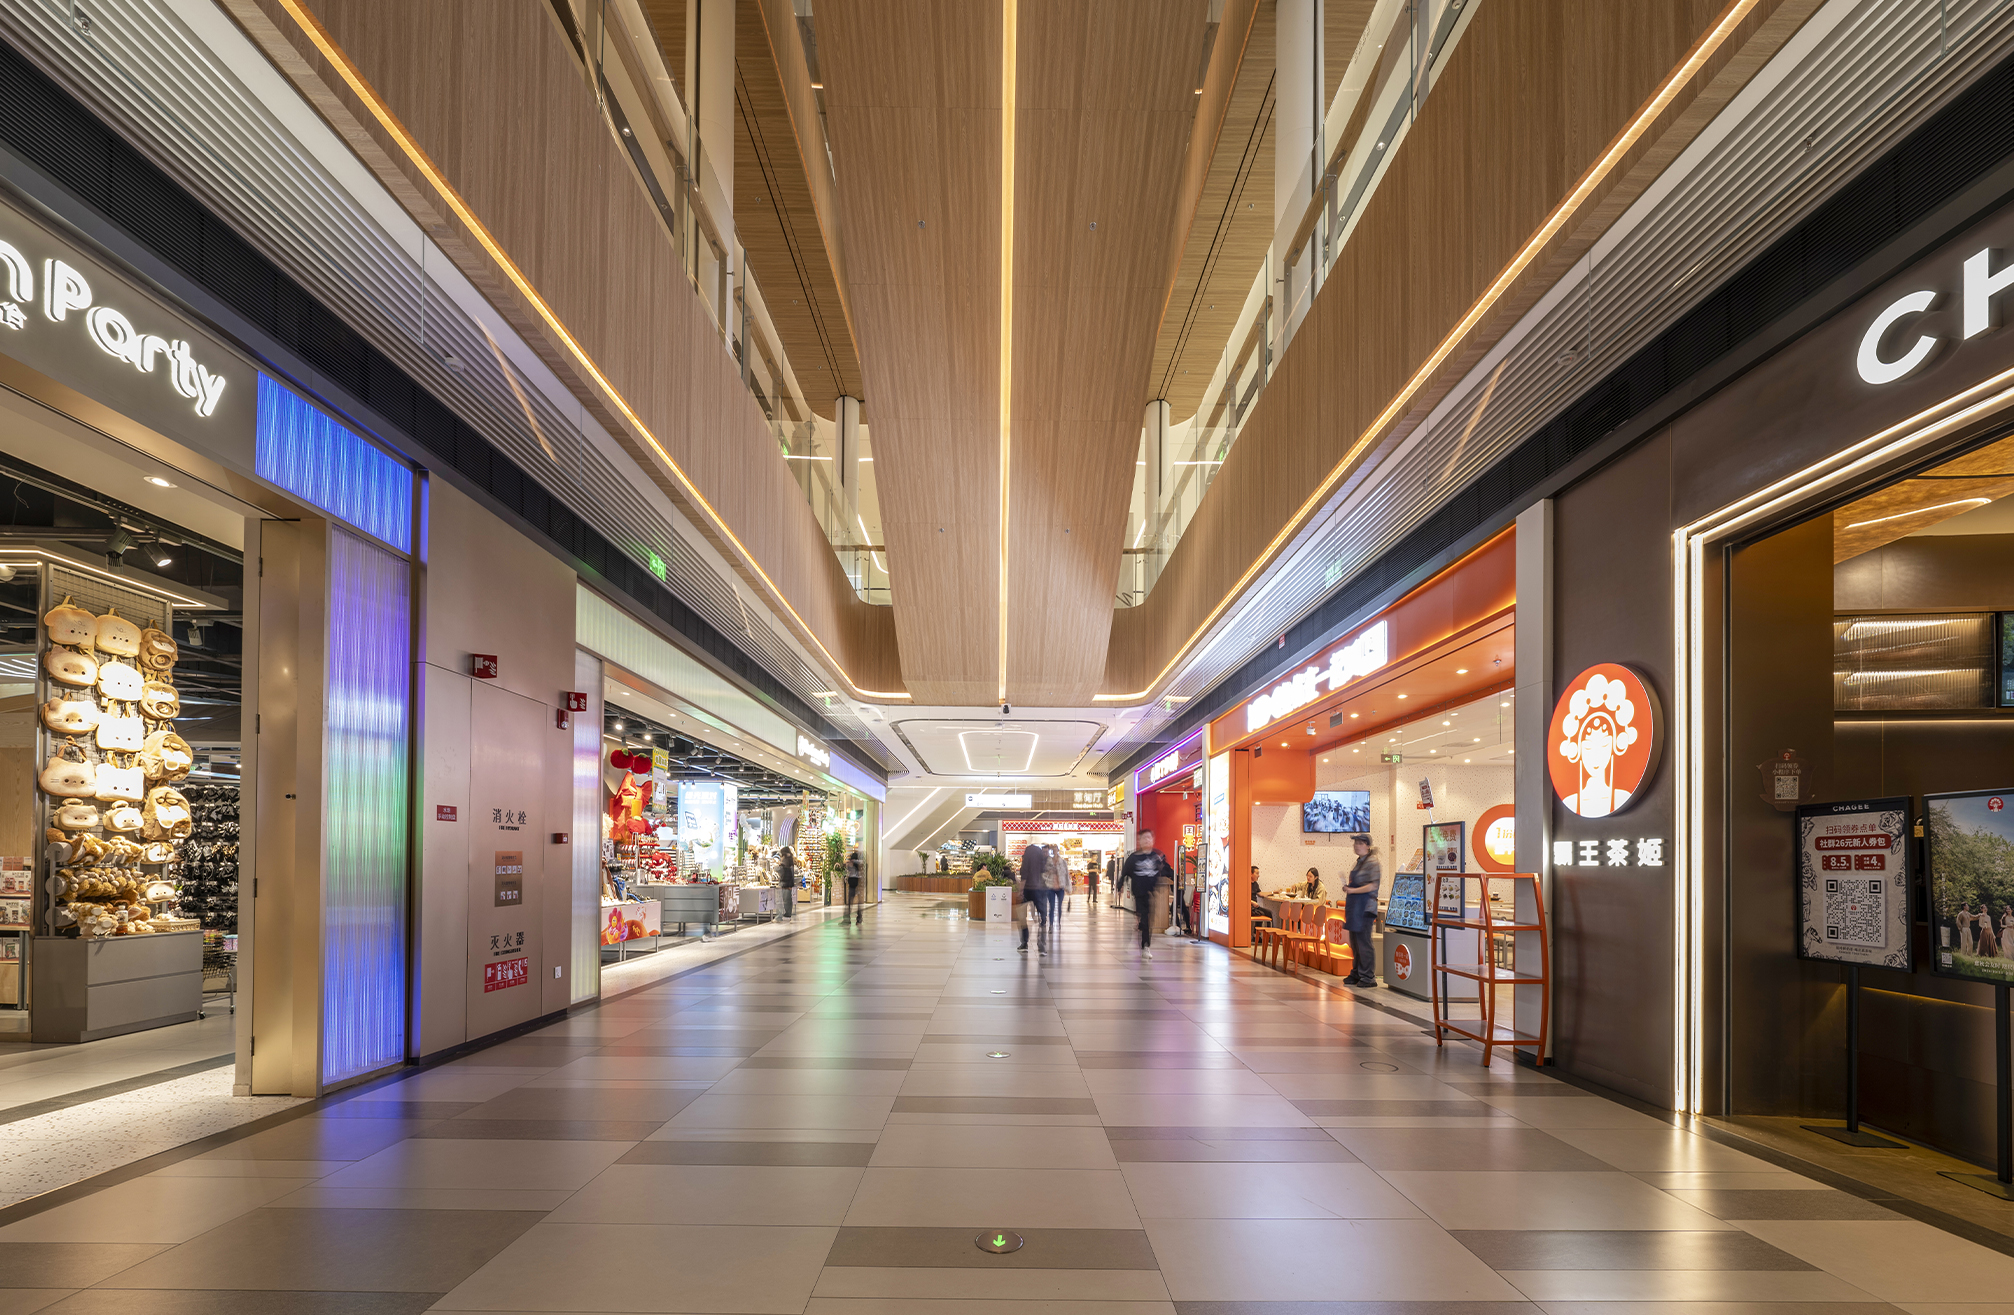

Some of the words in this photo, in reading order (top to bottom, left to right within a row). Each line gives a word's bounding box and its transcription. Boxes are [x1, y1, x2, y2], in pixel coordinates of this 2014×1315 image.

[44, 258, 226, 417] Party
[492, 808, 527, 825] 消火栓
[1832, 803, 1870, 812] CHAGEE
[490, 931, 525, 950] 灭火器
